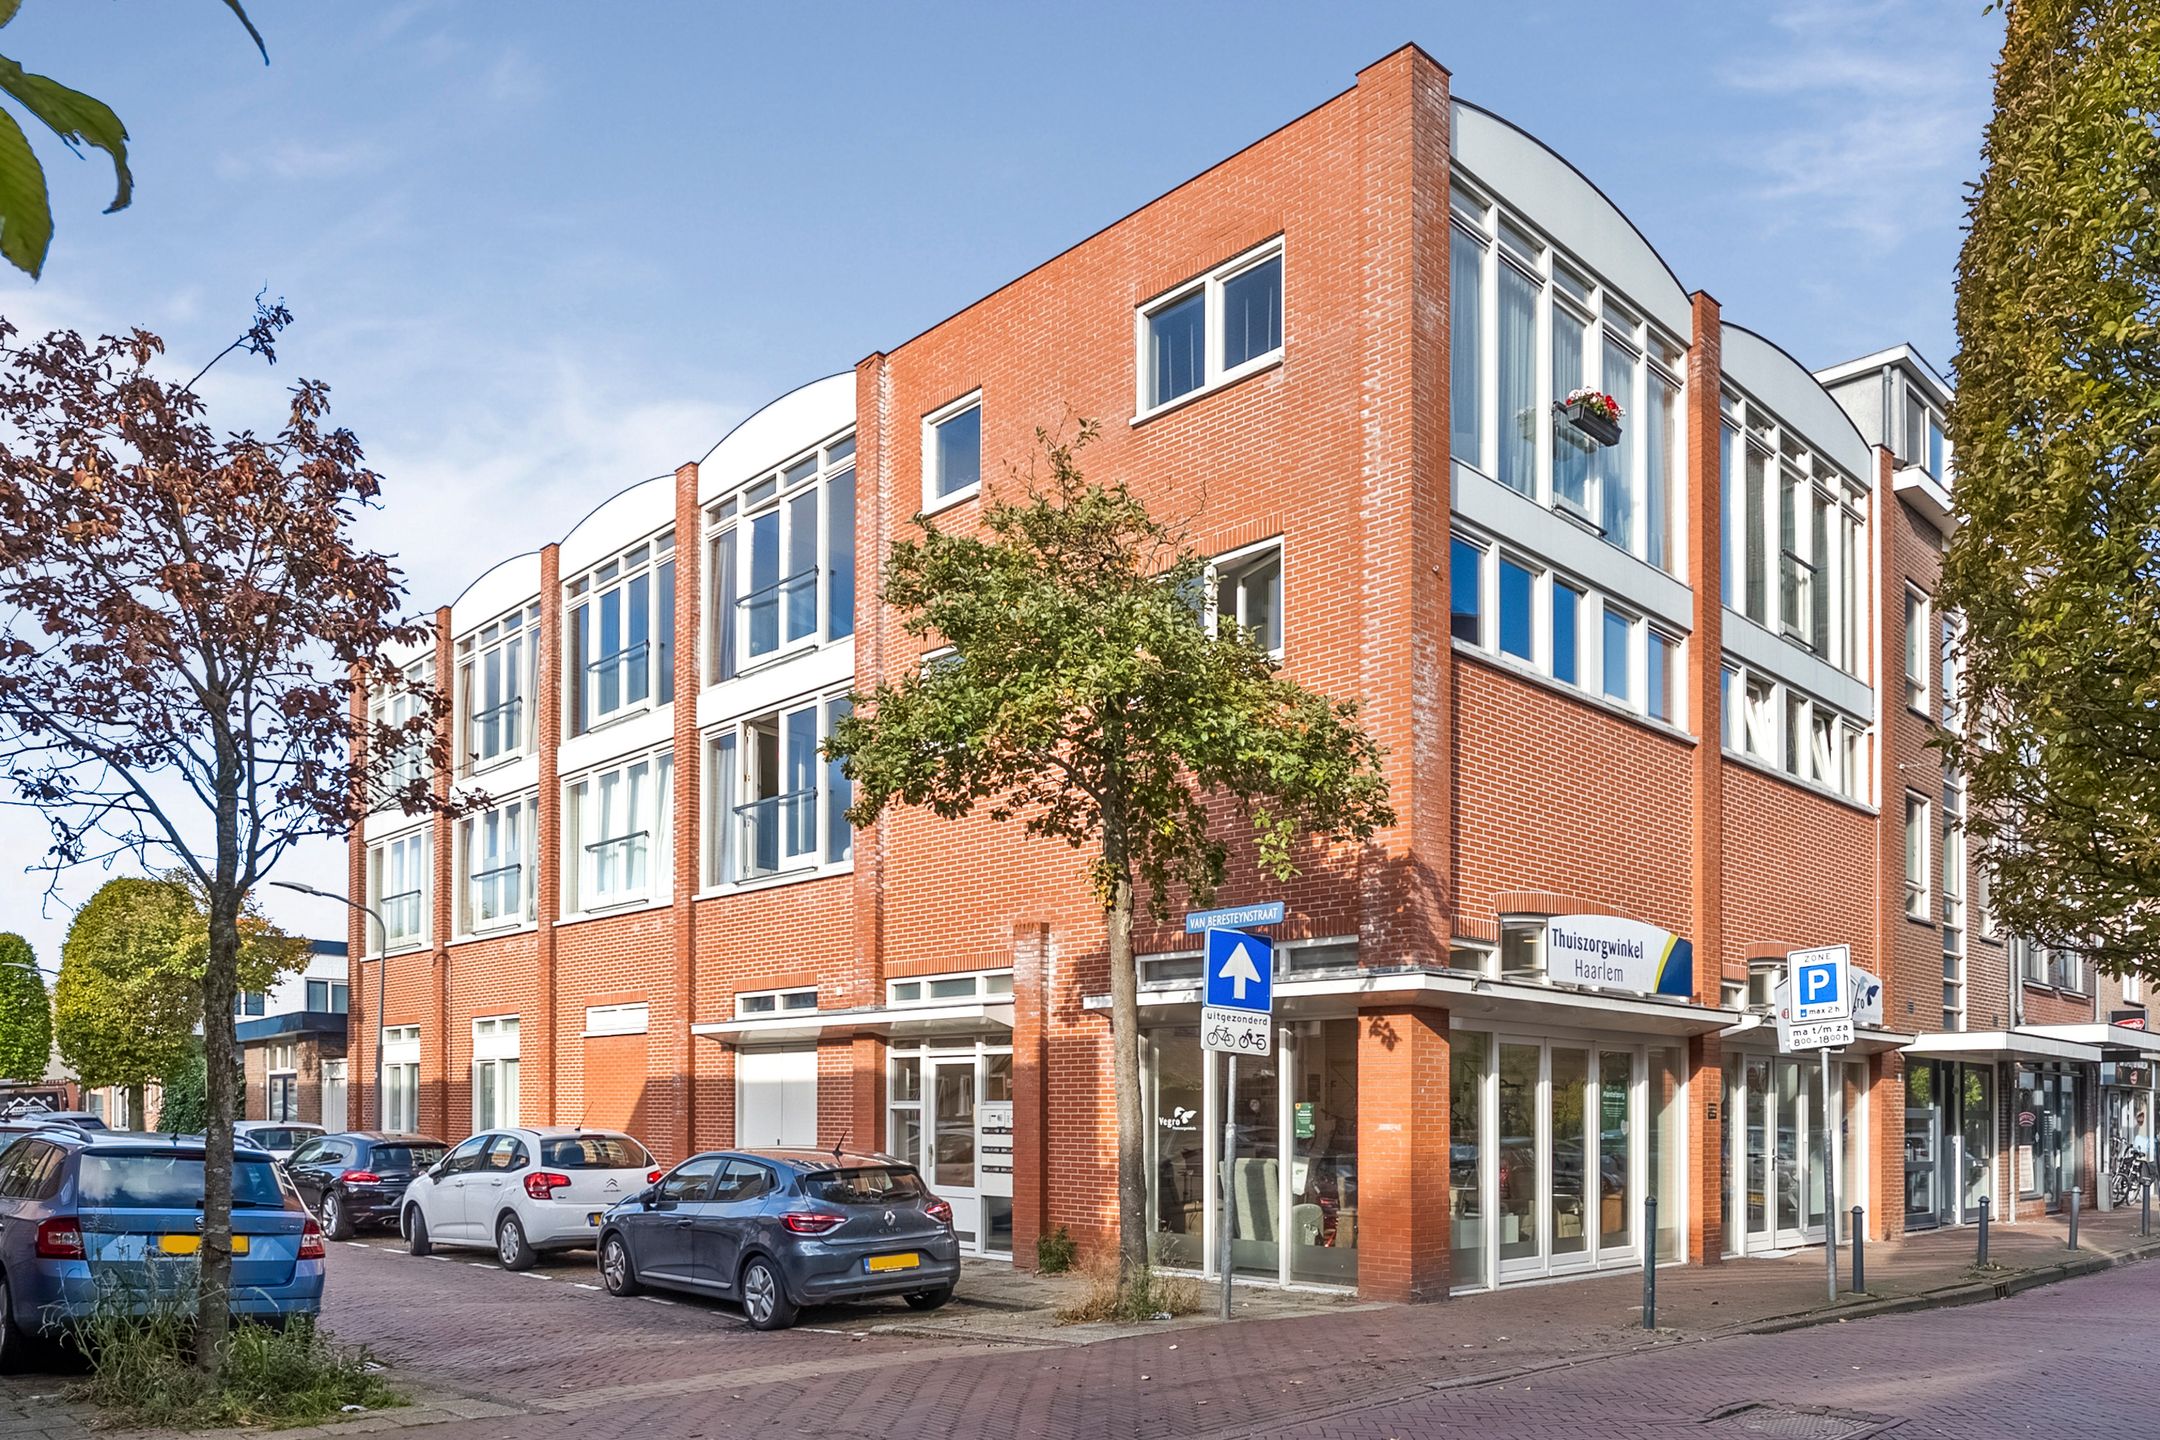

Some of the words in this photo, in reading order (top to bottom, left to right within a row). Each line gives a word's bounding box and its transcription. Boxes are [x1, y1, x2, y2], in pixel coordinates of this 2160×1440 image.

[1190, 916, 1206, 929] VAN
[1207, 907, 1279, 926] BERESTEYNSTRAAT
[1552, 927, 1644, 960] Thuiszorgwinkel
[1804, 952, 1832, 963] ZONE
[1575, 958, 1624, 983] Haarlem
[1807, 968, 1830, 1001] P
[1808, 1007, 1825, 1015] max
[1827, 1006, 1833, 1014] 2
[1206, 1011, 1268, 1026] uitgezonderd
[1793, 1029, 1808, 1037] ma
[1812, 1025, 1832, 1035] t/m
[1836, 1024, 1849, 1032] za
[1158, 1116, 1180, 1129] Vegro
